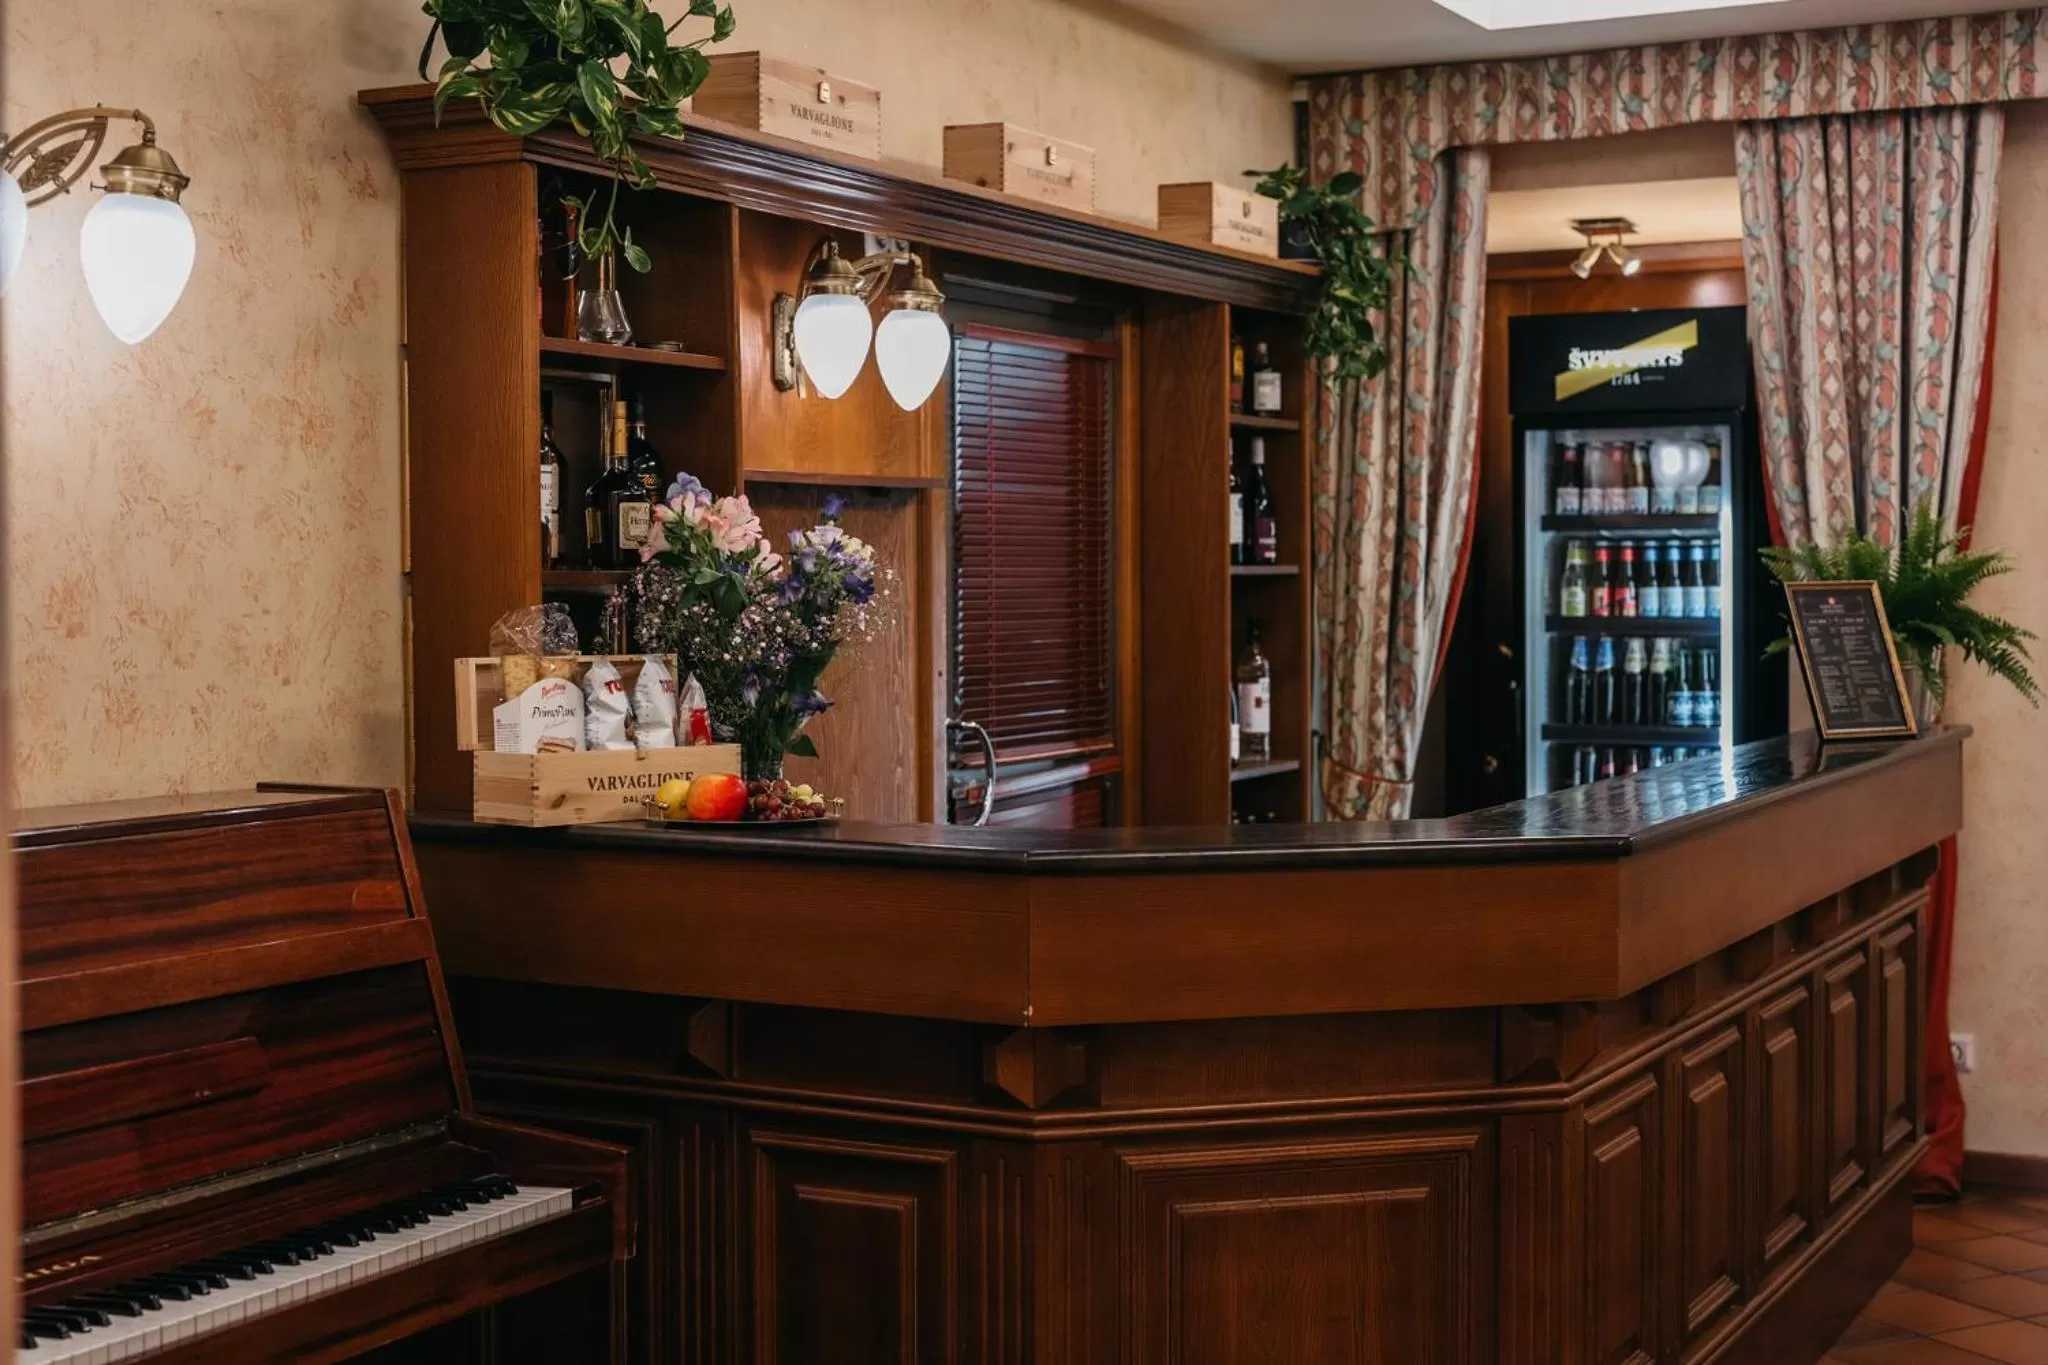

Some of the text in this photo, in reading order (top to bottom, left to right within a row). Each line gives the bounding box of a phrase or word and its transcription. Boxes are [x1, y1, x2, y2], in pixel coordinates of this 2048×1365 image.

[791, 104, 854, 133] VARVAGLIONE
[587, 770, 695, 791] VARVAGLIONE
[623, 795, 640, 804] DAL
